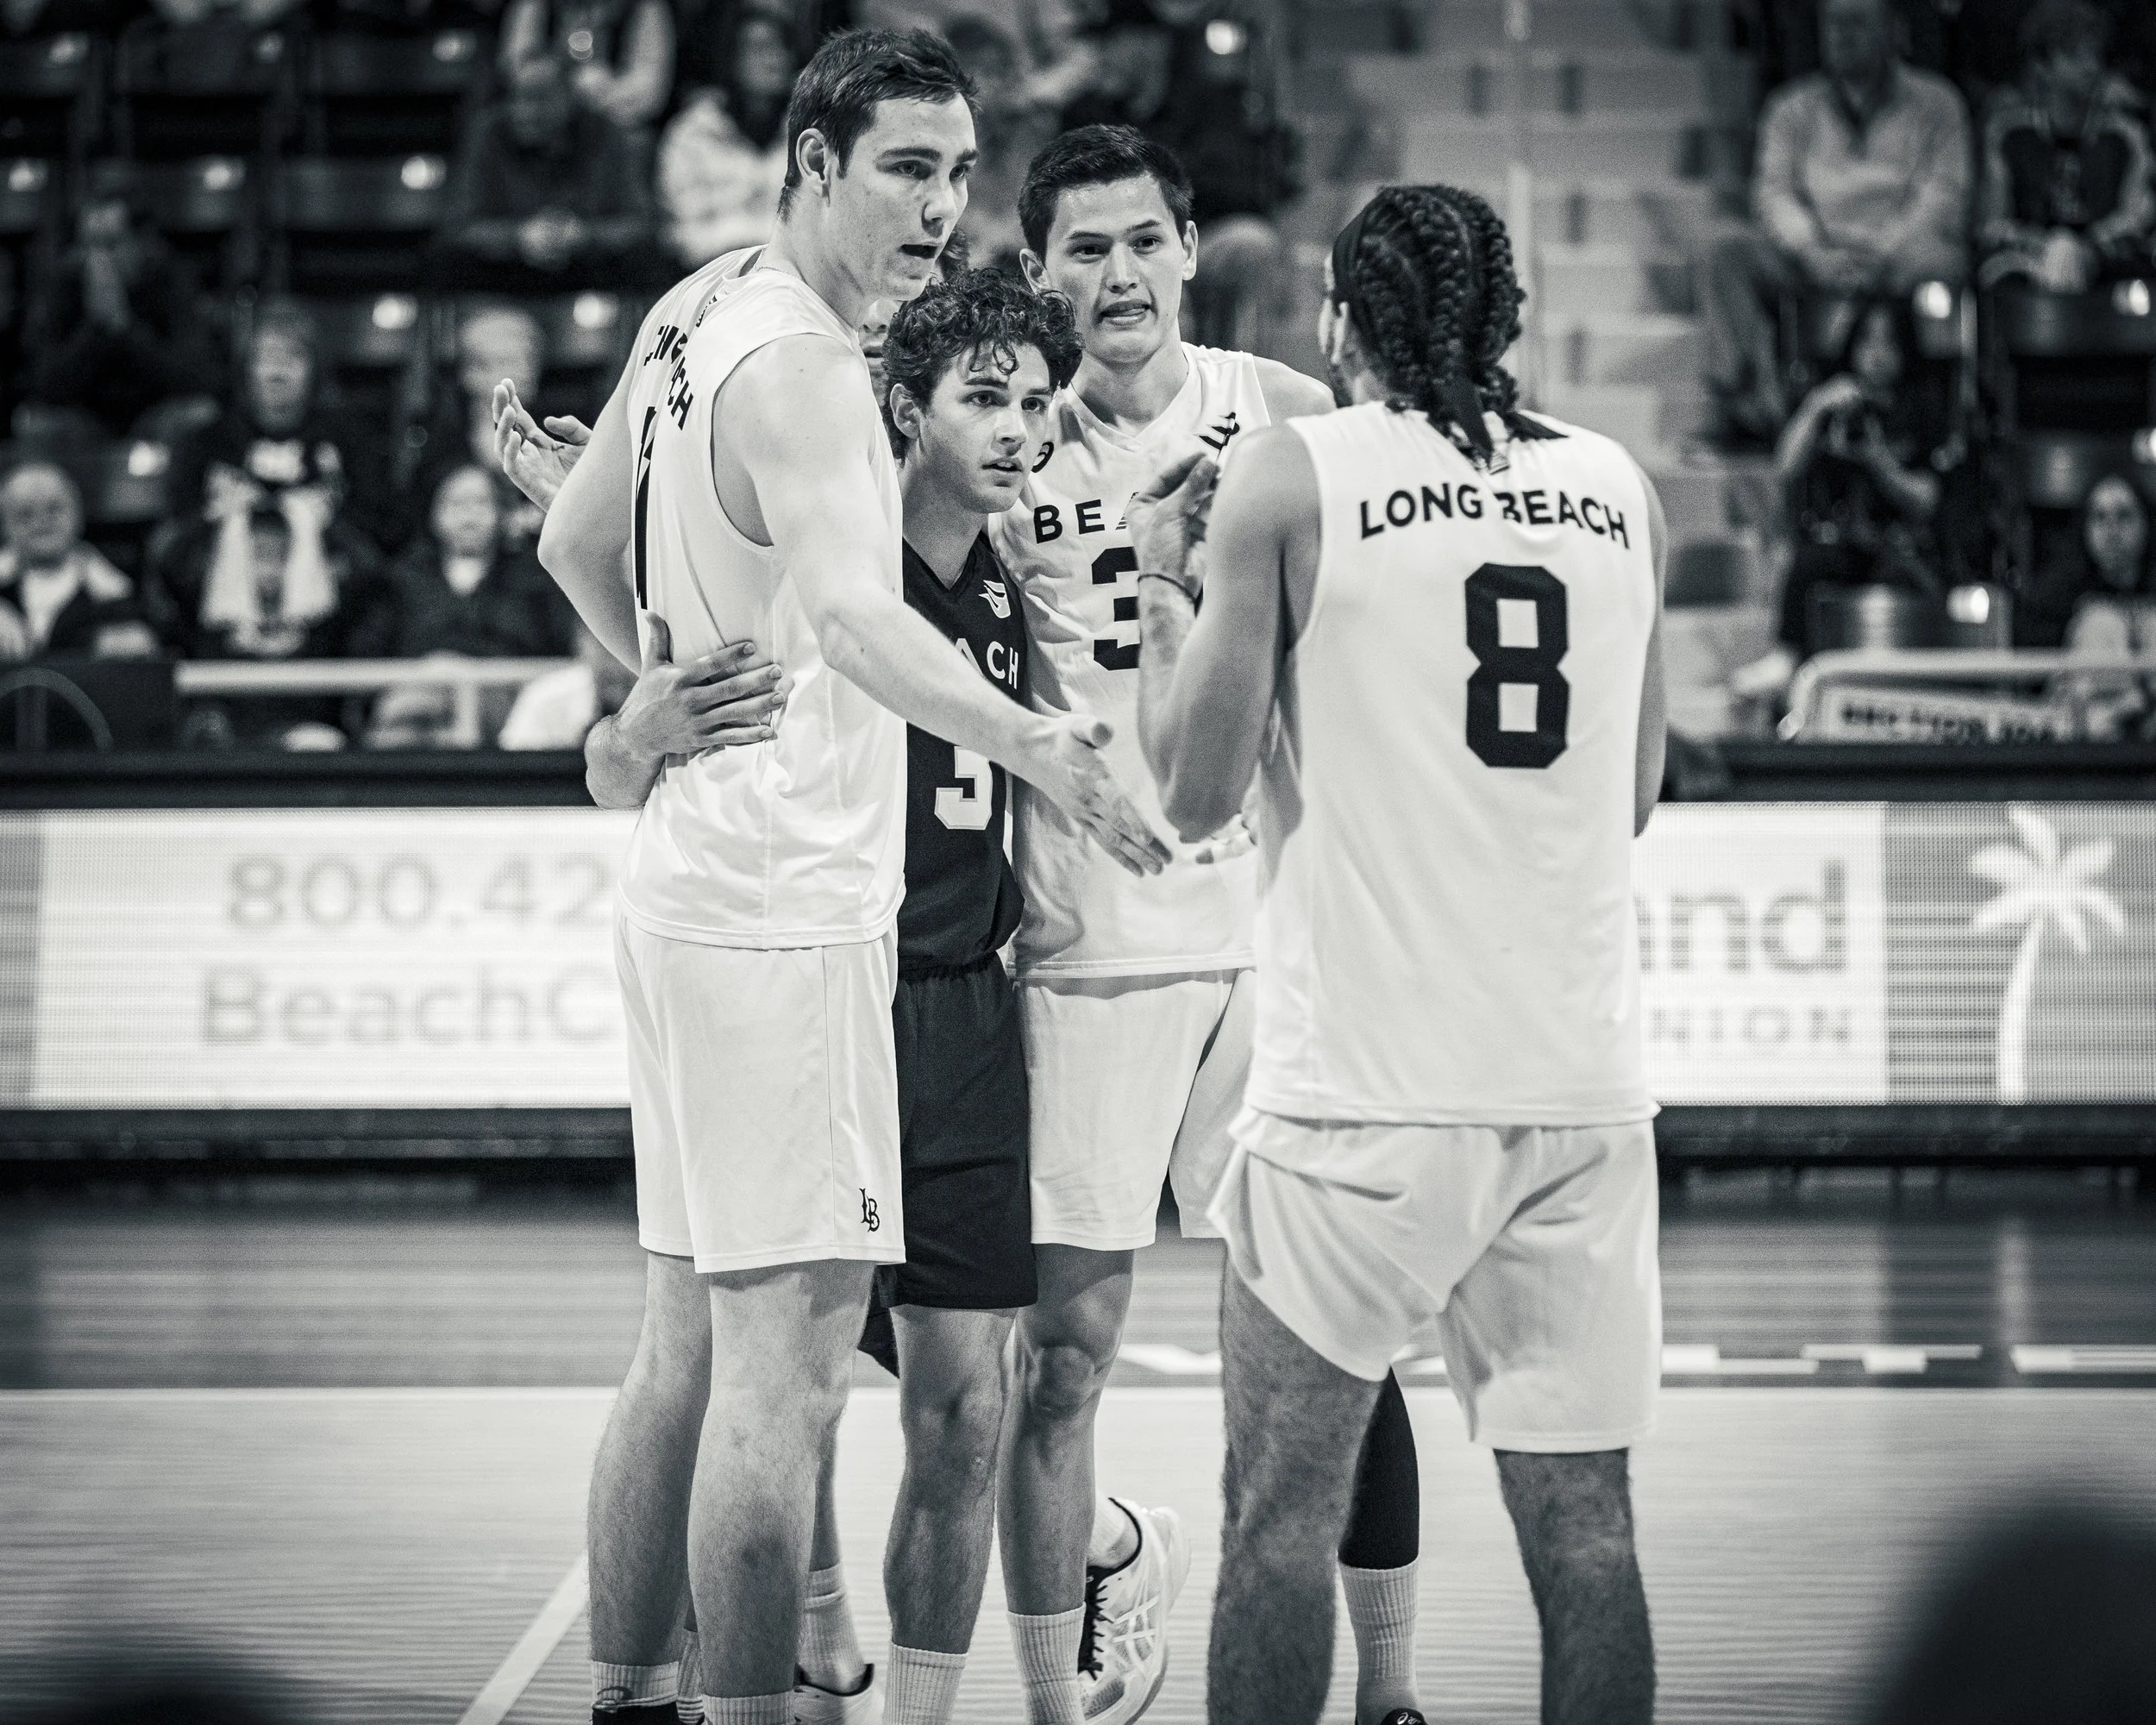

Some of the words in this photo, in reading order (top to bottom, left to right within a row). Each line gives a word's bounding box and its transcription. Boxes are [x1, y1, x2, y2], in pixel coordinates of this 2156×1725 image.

[1359, 481, 1484, 540] LONG
[1493, 489, 1631, 550] BEACH
[1464, 561, 1571, 770] 8
[225, 852, 611, 931] 800.42
[859, 1188, 881, 1233] LB
